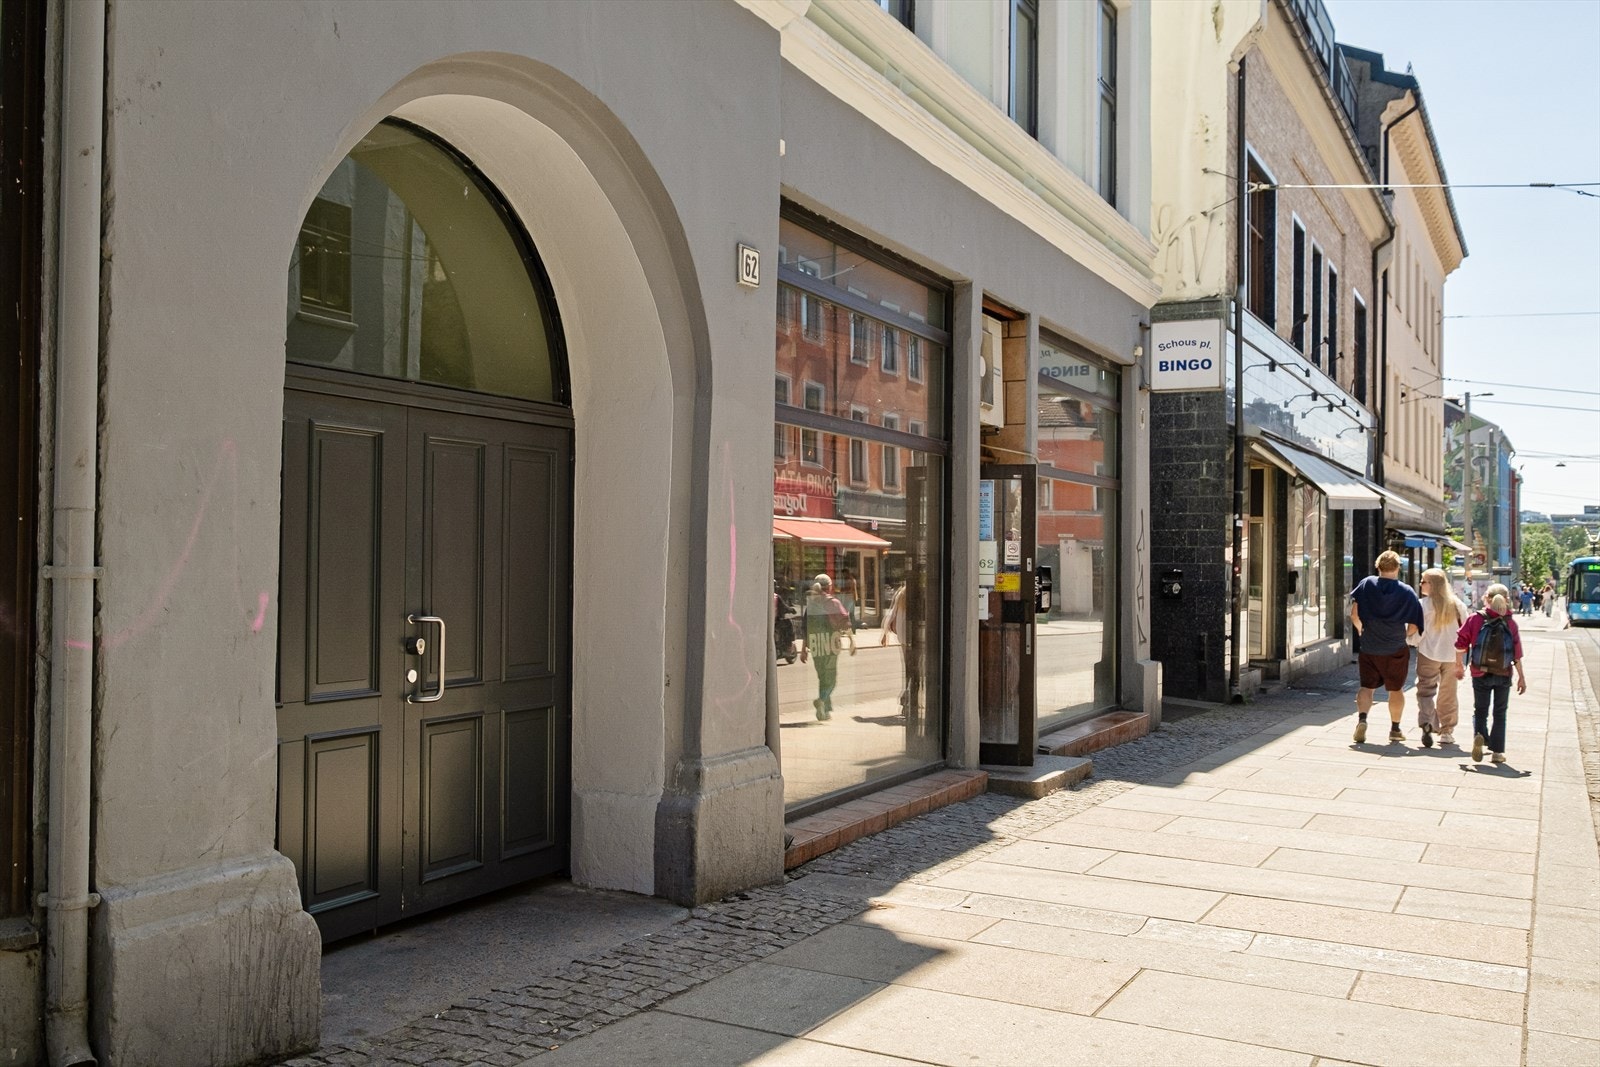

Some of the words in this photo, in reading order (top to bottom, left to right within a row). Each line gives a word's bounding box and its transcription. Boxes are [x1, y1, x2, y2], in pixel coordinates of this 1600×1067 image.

[745, 253, 758, 279] 62
[1158, 339, 1197, 351] Schous
[1199, 340, 1212, 350] pl.
[1159, 358, 1212, 372] BINGO
[806, 473, 840, 497] BINGO
[979, 558, 994, 569] 62
